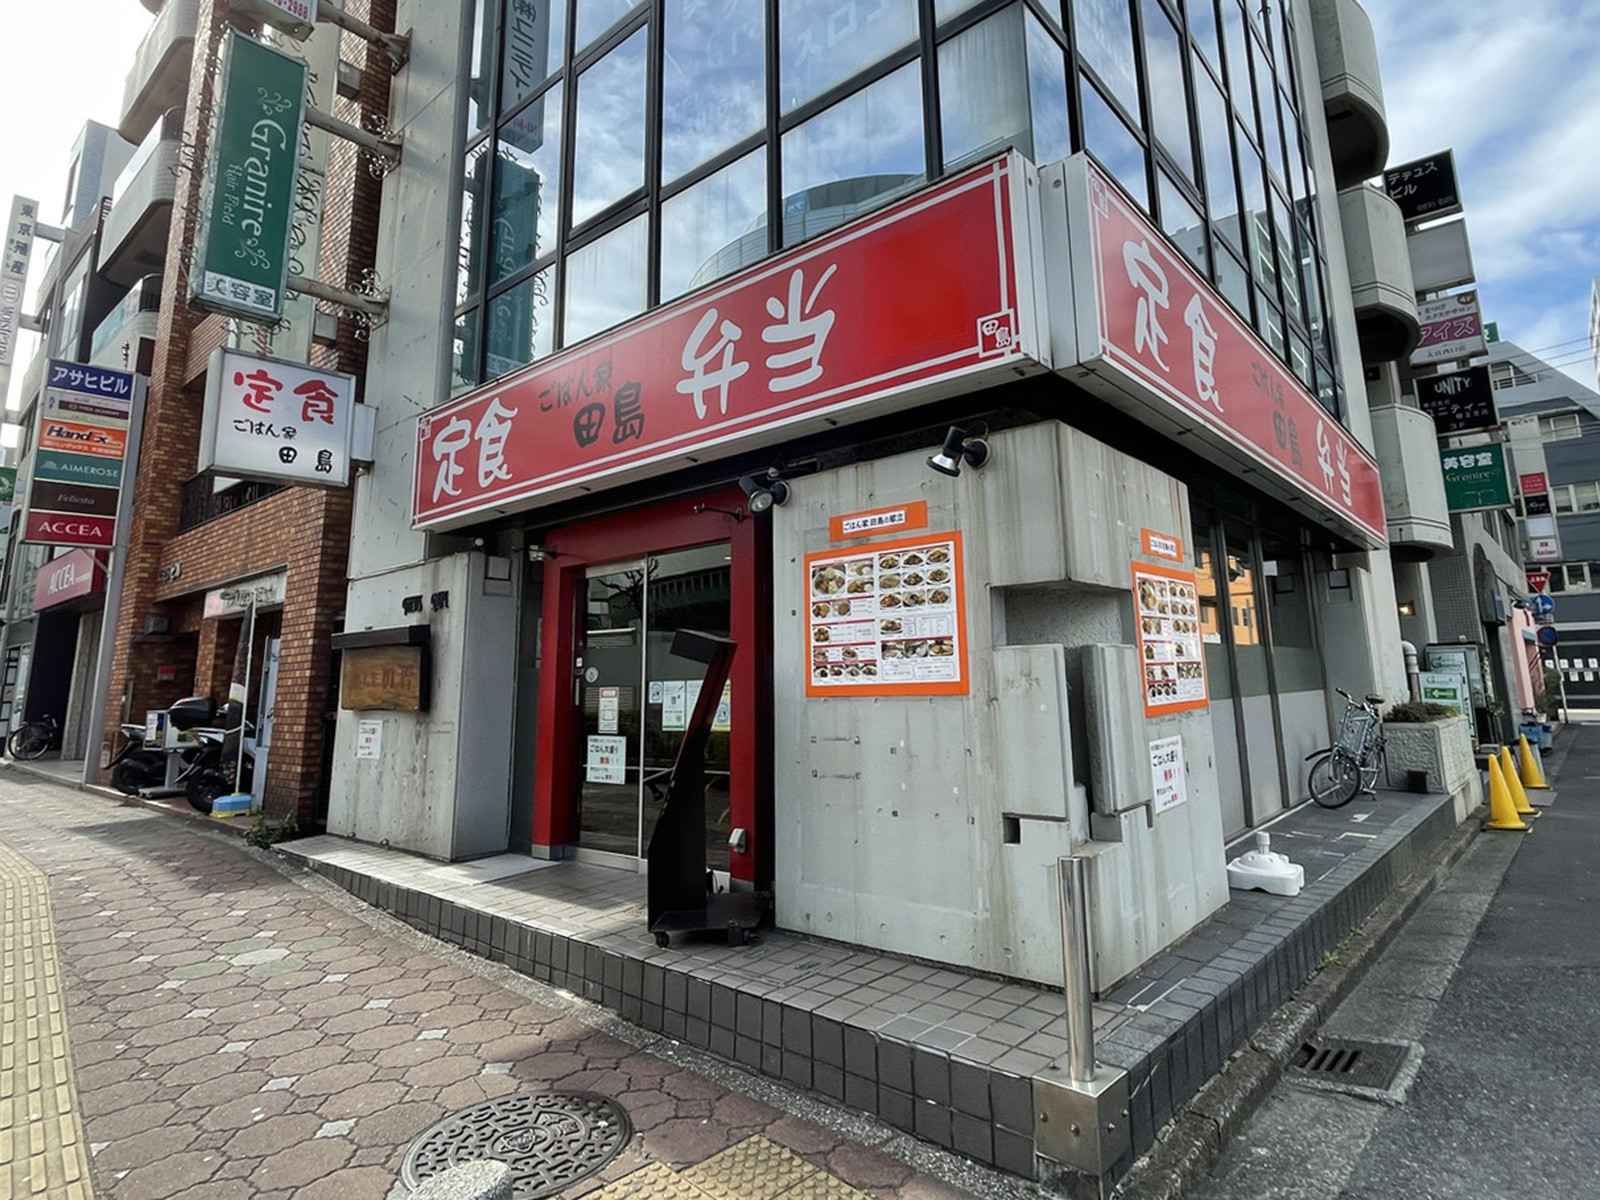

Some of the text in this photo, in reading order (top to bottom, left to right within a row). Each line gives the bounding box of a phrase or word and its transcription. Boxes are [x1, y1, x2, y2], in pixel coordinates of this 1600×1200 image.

[241, 118, 287, 237] Granire
[221, 195, 240, 225] Field
[675, 262, 838, 420] 弁当
[982, 319, 1011, 348] 田島
[52, 366, 129, 394] アサヒビル
[1434, 376, 1471, 395] UNITY
[233, 368, 340, 426] 定食
[232, 417, 298, 441] ごはん家
[572, 380, 646, 449] 田島
[278, 446, 333, 474] 田島
[432, 397, 519, 503] 定食
[1443, 451, 1493, 471] 美容室
[60, 463, 119, 478] AIMEROSE
[38, 521, 103, 537] ACCEA
[48, 562, 76, 594] ACCEA
